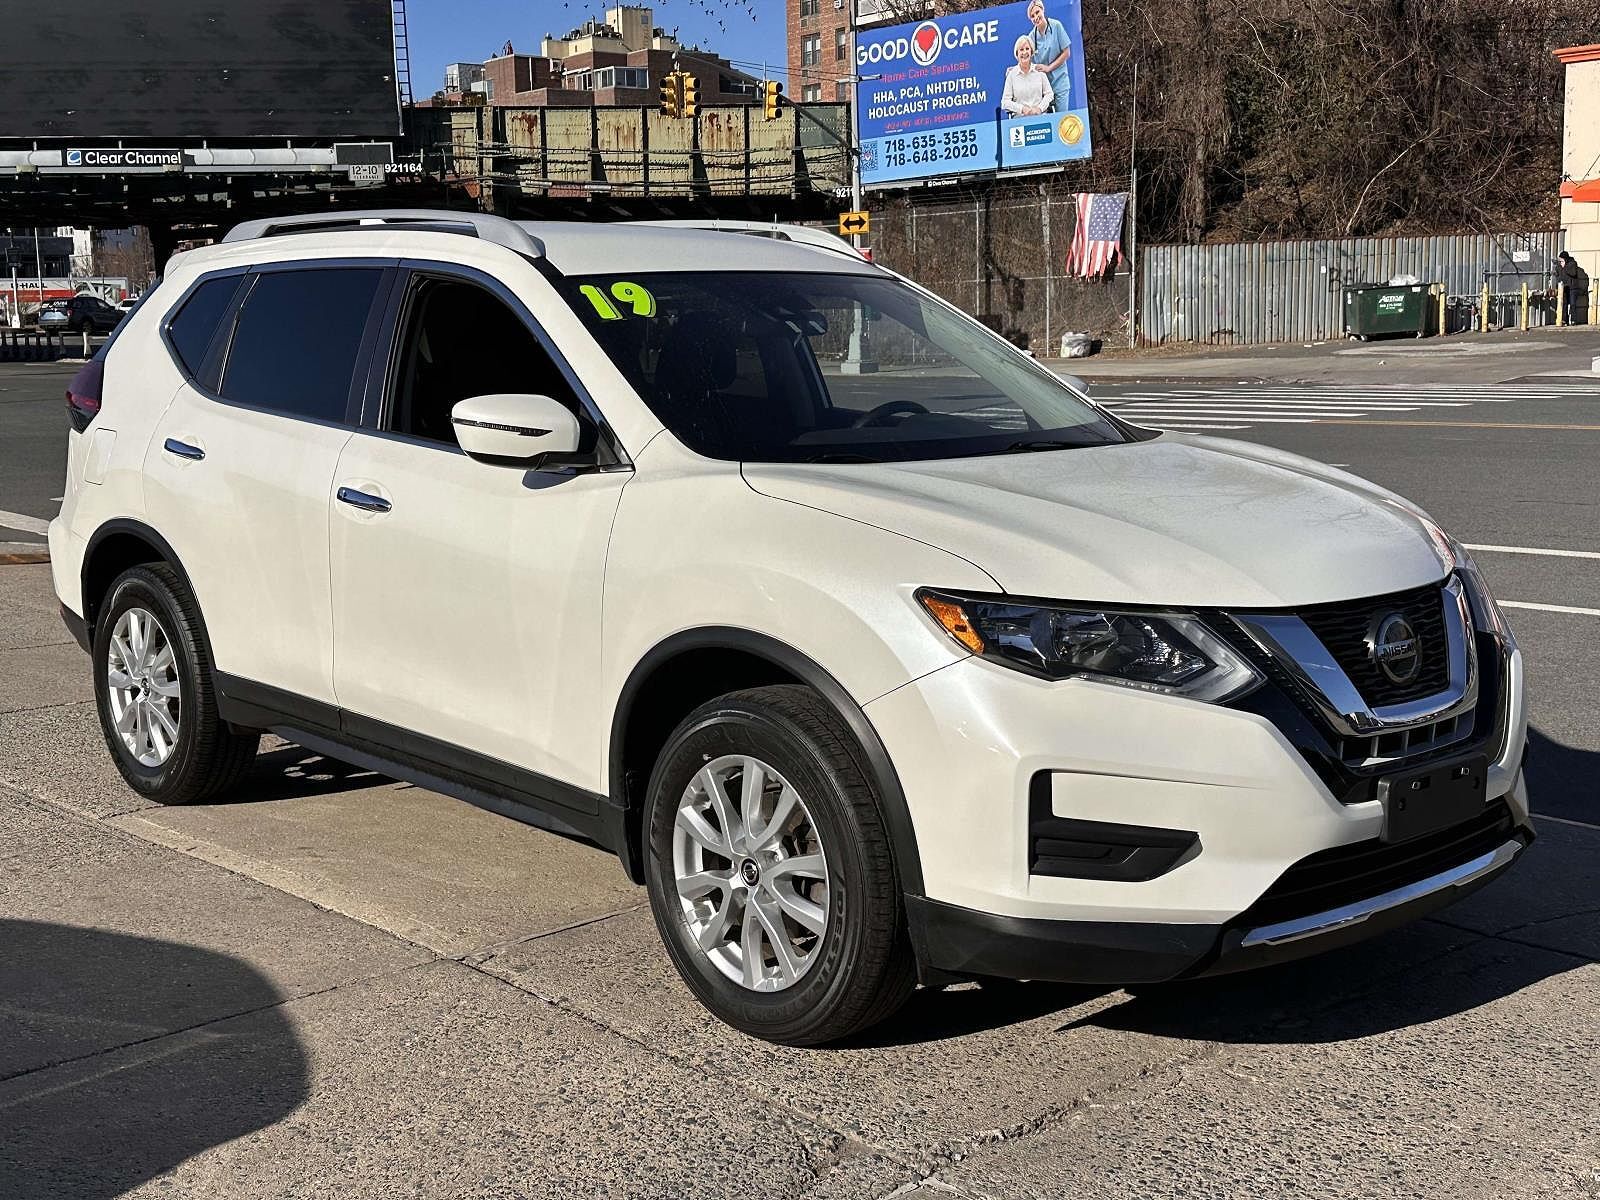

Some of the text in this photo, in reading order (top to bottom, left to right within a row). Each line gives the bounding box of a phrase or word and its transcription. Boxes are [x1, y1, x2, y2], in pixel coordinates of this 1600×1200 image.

[856, 20, 999, 65] GOOD CARE
[909, 69, 929, 79] Care
[931, 62, 969, 75] Services
[873, 77, 980, 104] HHA, PCA, NHTD/TBI,
[868, 91, 987, 119] HOLOCAUST PROGRAM
[885, 129, 976, 154] 718-635-3535
[84, 151, 181, 164] Clear Channel
[385, 163, 422, 173] 921164
[885, 144, 978, 168] 718-648-2020
[352, 165, 377, 175] 12-10
[836, 186, 865, 198] 92114
[579, 281, 656, 320] 19
